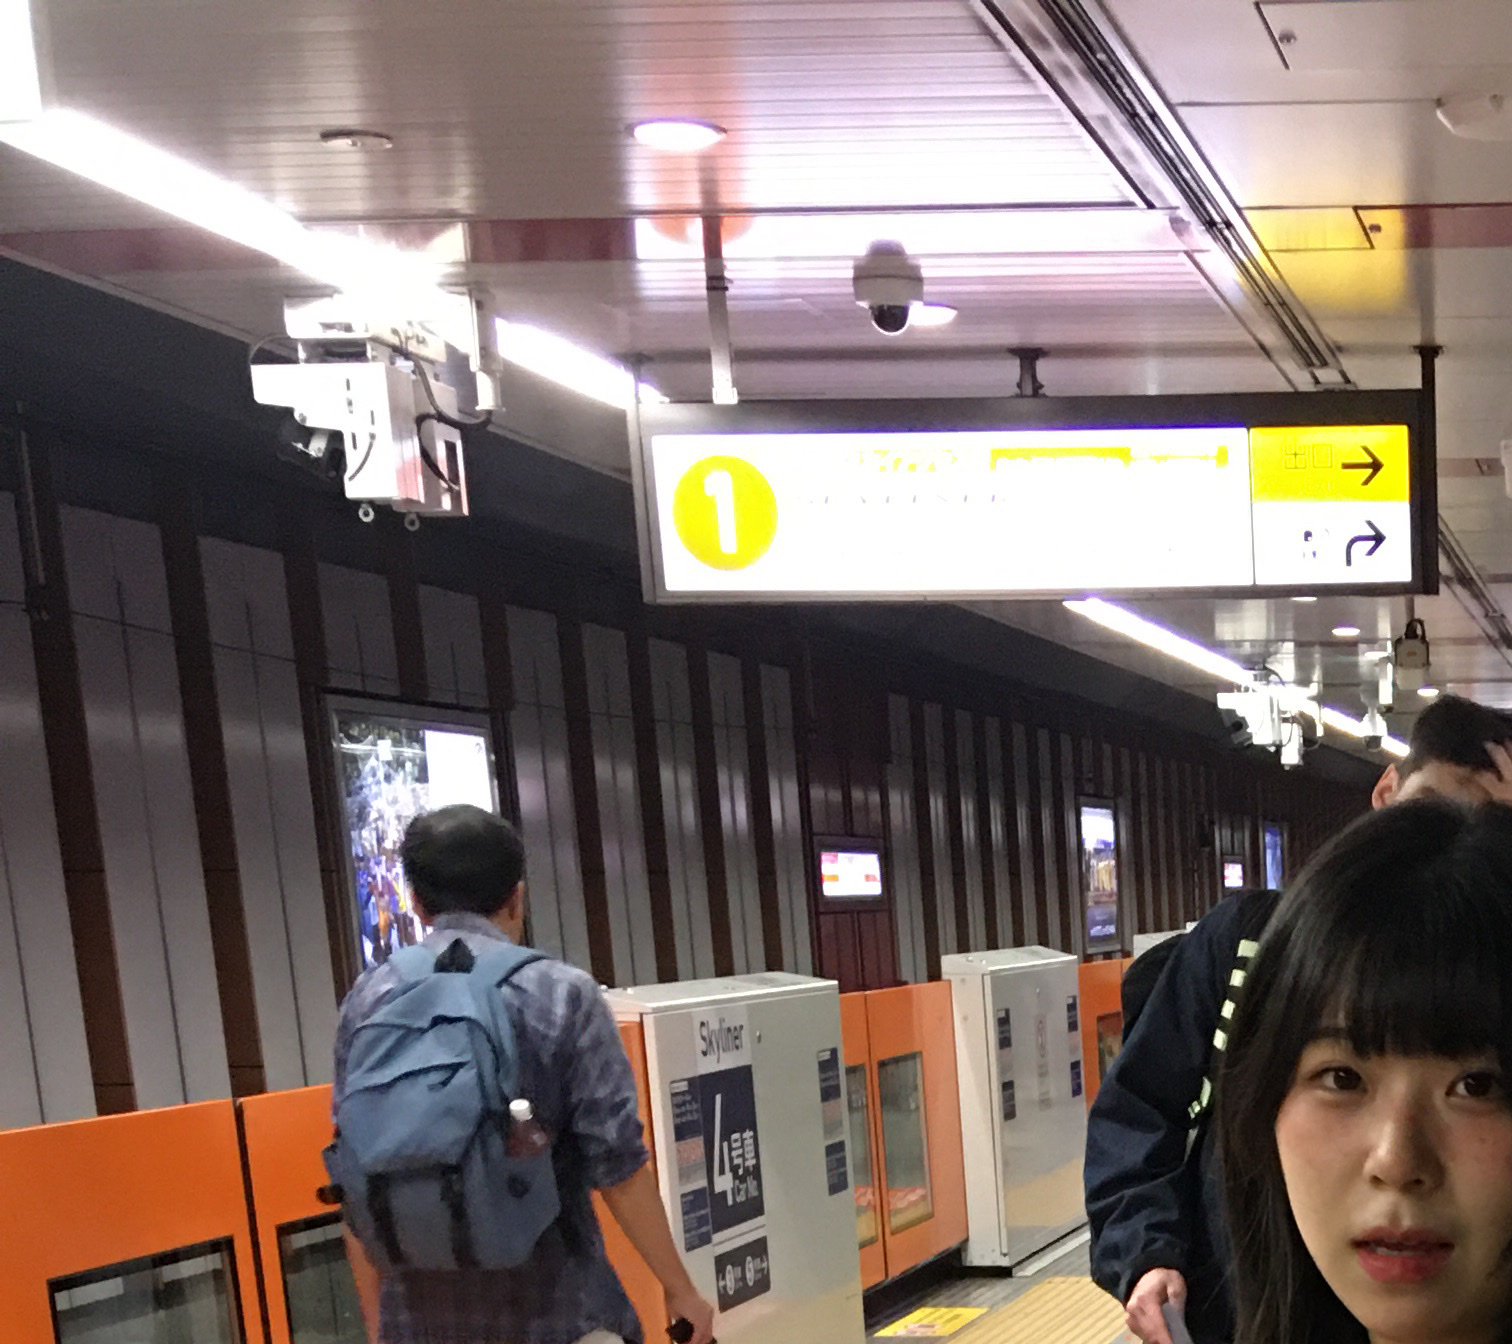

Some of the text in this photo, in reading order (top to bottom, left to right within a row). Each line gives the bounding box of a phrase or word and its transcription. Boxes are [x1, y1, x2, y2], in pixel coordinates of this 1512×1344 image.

[703, 470, 737, 555] 1
[699, 1017, 744, 1063] Skyliner
[713, 1093, 733, 1206] 4
[730, 1129, 755, 1175] 号車
